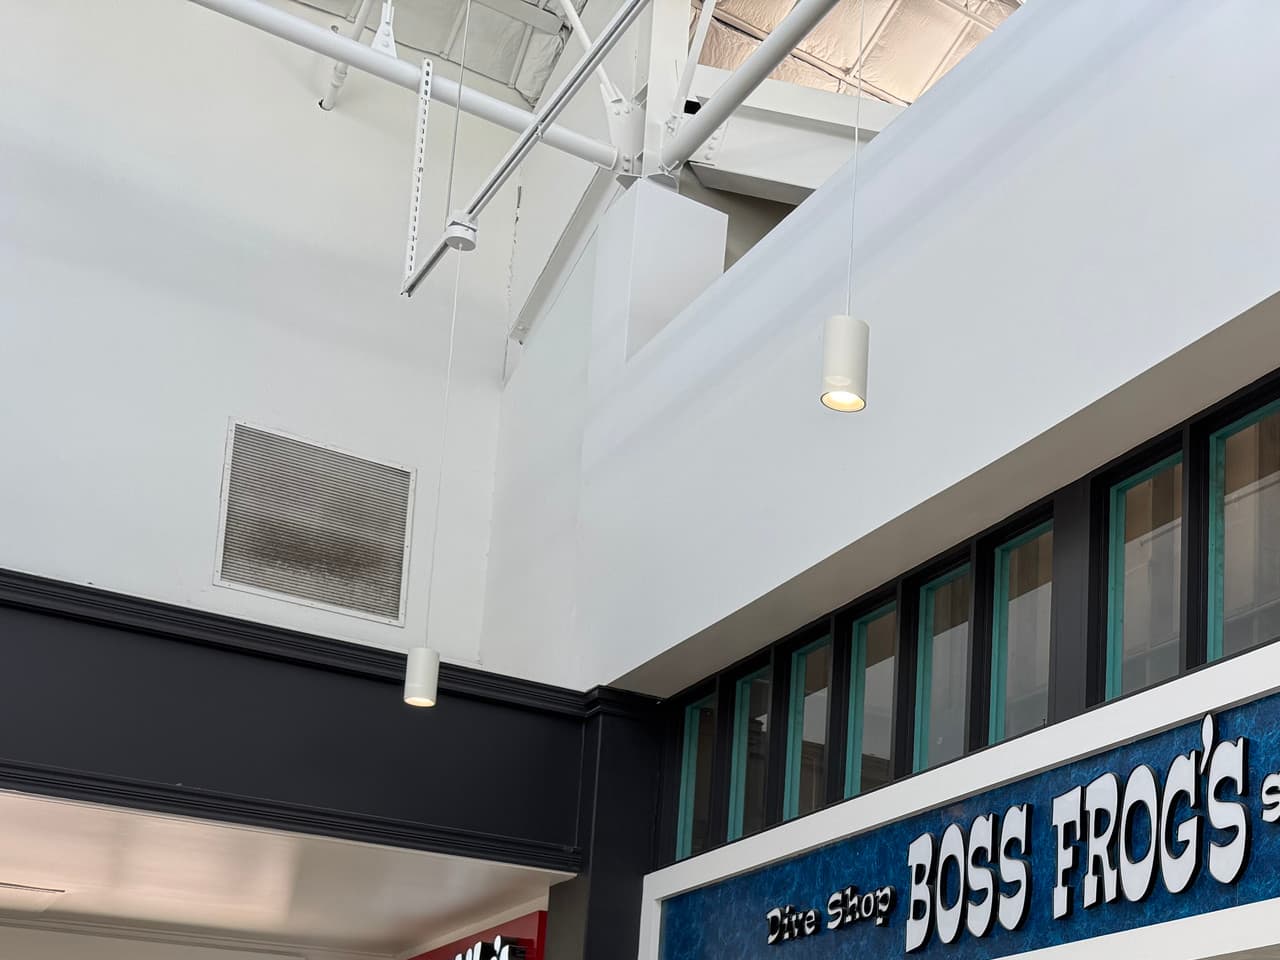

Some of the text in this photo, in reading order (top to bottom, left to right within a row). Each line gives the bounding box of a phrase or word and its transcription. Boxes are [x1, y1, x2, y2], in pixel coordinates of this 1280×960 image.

[766, 905, 820, 945] Dive
[827, 884, 896, 930] Shop
[905, 803, 1032, 953] BOSS
[1052, 712, 1248, 920] FROG'S
